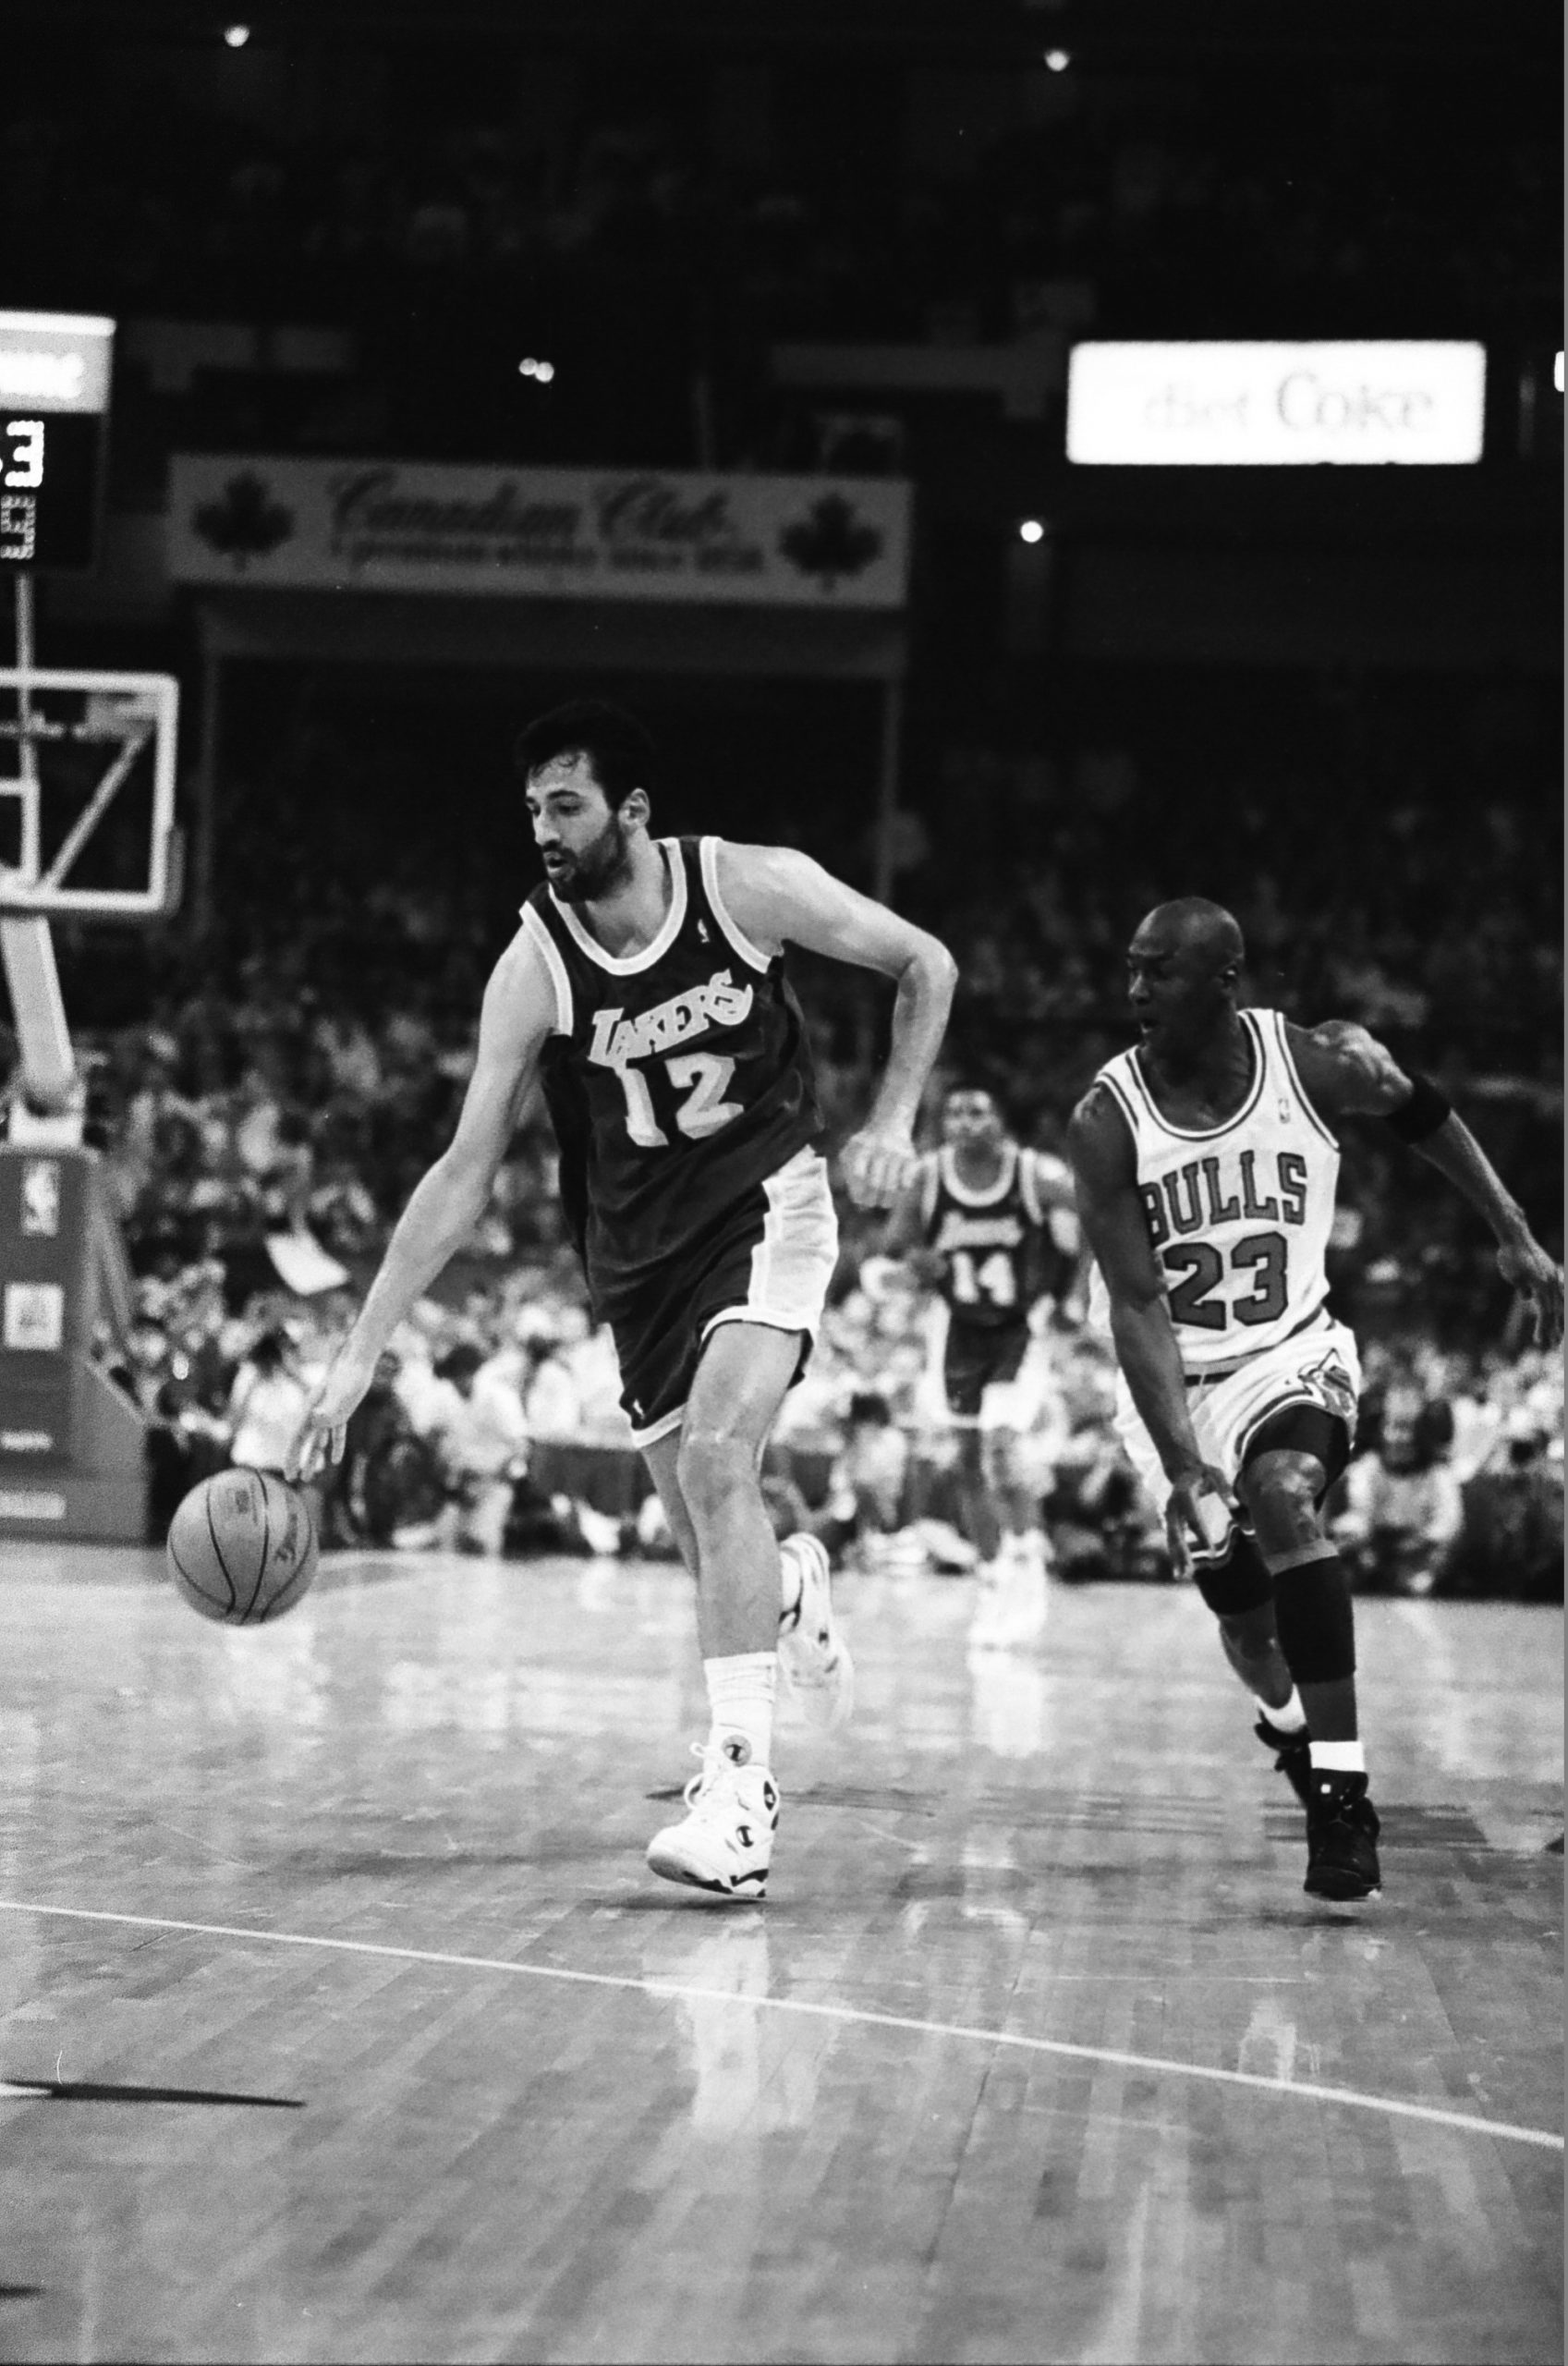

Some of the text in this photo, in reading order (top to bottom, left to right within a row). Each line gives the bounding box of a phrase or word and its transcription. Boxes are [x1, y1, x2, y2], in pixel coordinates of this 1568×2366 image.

[1275, 369, 1434, 433] Coke
[588, 968, 754, 1068] LAKERS
[614, 1052, 745, 1148] 12
[1139, 1149, 1308, 1249] BULLS
[952, 1250, 1015, 1306] 14
[1161, 1231, 1289, 1331] 23
